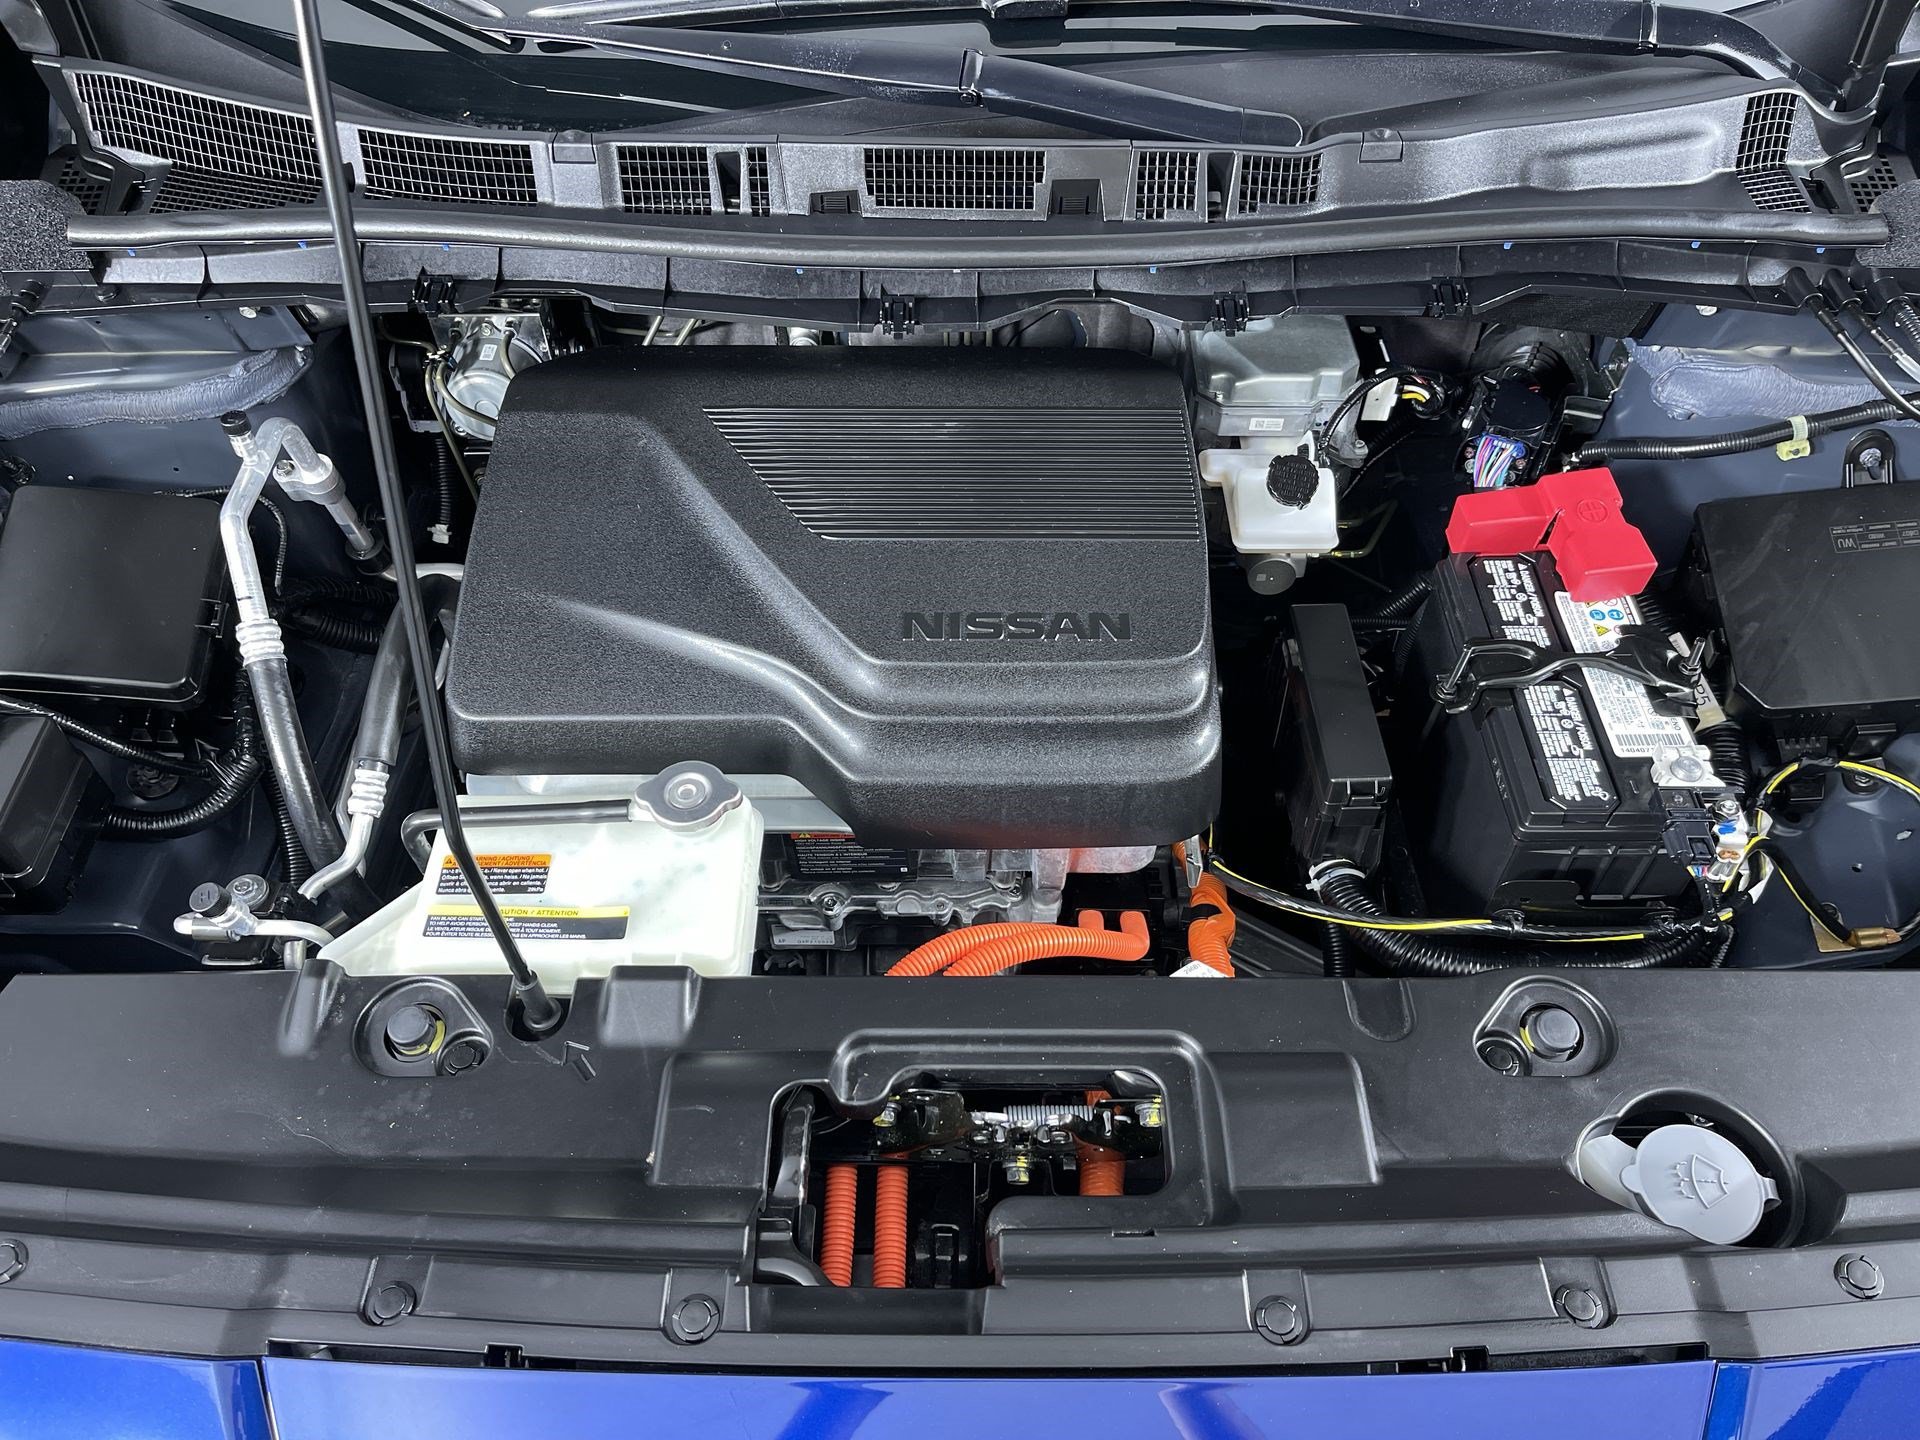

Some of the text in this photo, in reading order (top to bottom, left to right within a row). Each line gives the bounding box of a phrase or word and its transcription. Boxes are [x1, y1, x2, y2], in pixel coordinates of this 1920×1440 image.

[1521, 570, 1536, 592] DANGER
[1529, 596, 1545, 618] POISON
[902, 611, 1132, 642] NISSAN
[1565, 696, 1583, 722] DANGER
[1576, 727, 1593, 750] POISON
